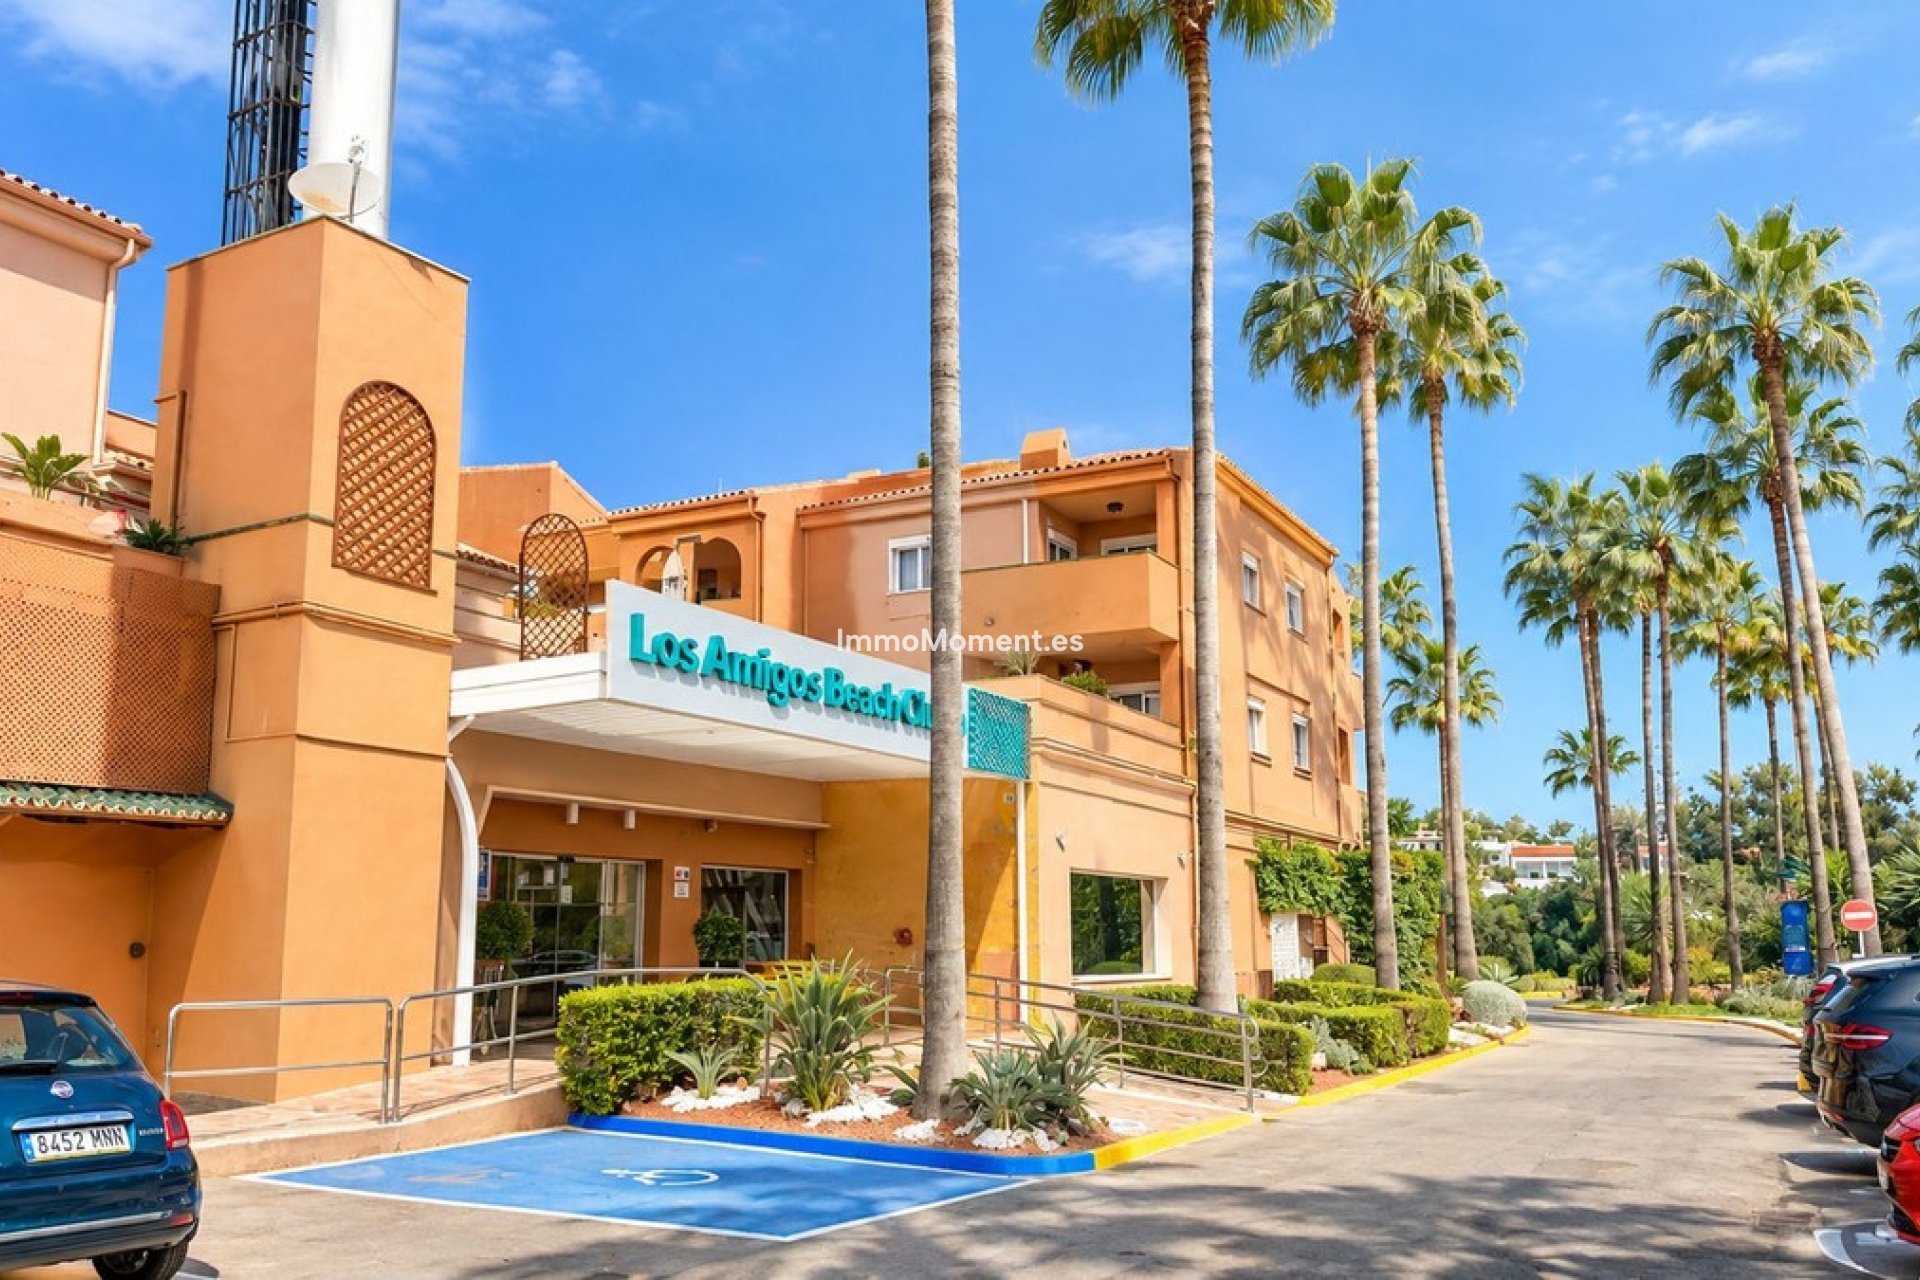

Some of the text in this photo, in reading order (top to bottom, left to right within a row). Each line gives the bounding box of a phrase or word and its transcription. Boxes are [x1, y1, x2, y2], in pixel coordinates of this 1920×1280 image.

[629, 612, 700, 674] Los
[700, 634, 823, 708] Amigos
[823, 666, 901, 721] Beach
[37, 1130, 86, 1154] 8452
[89, 1126, 126, 1149] MNN
